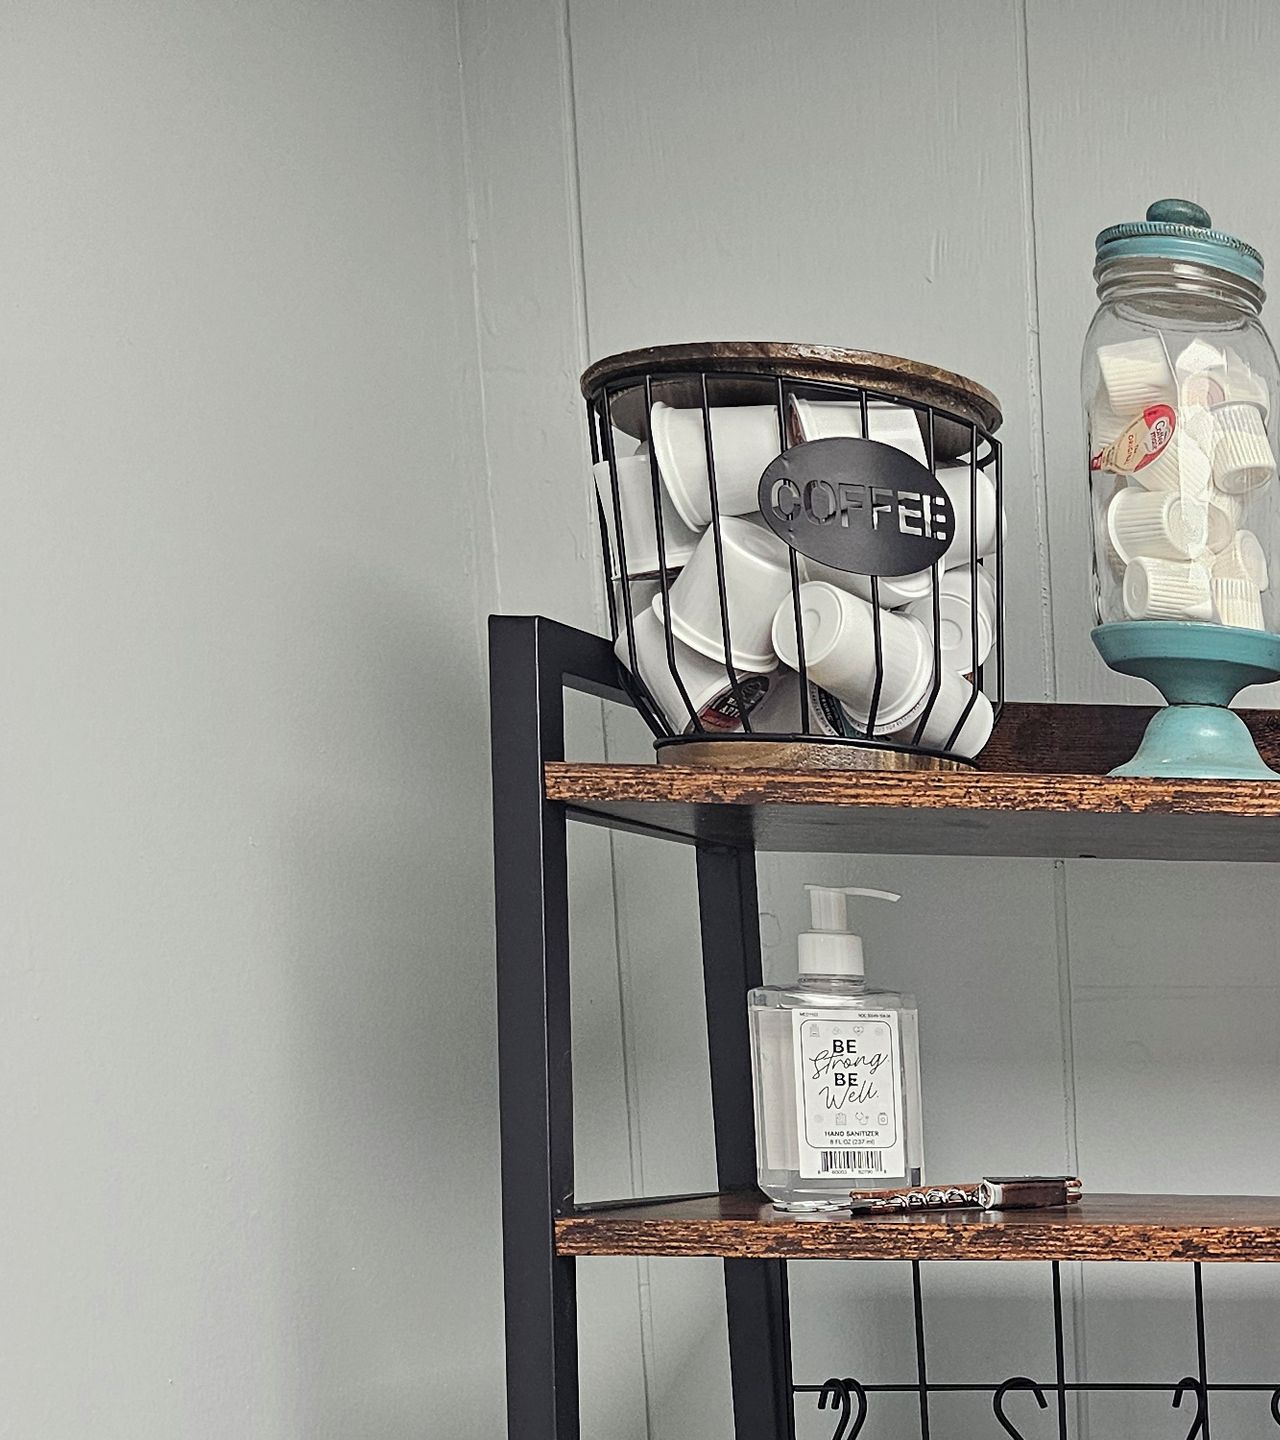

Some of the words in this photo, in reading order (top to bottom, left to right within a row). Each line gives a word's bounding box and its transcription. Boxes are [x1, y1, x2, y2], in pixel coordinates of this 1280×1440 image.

[771, 478, 947, 540] COFFEE
[832, 1039, 857, 1054] BE
[834, 1072, 859, 1087] BE
